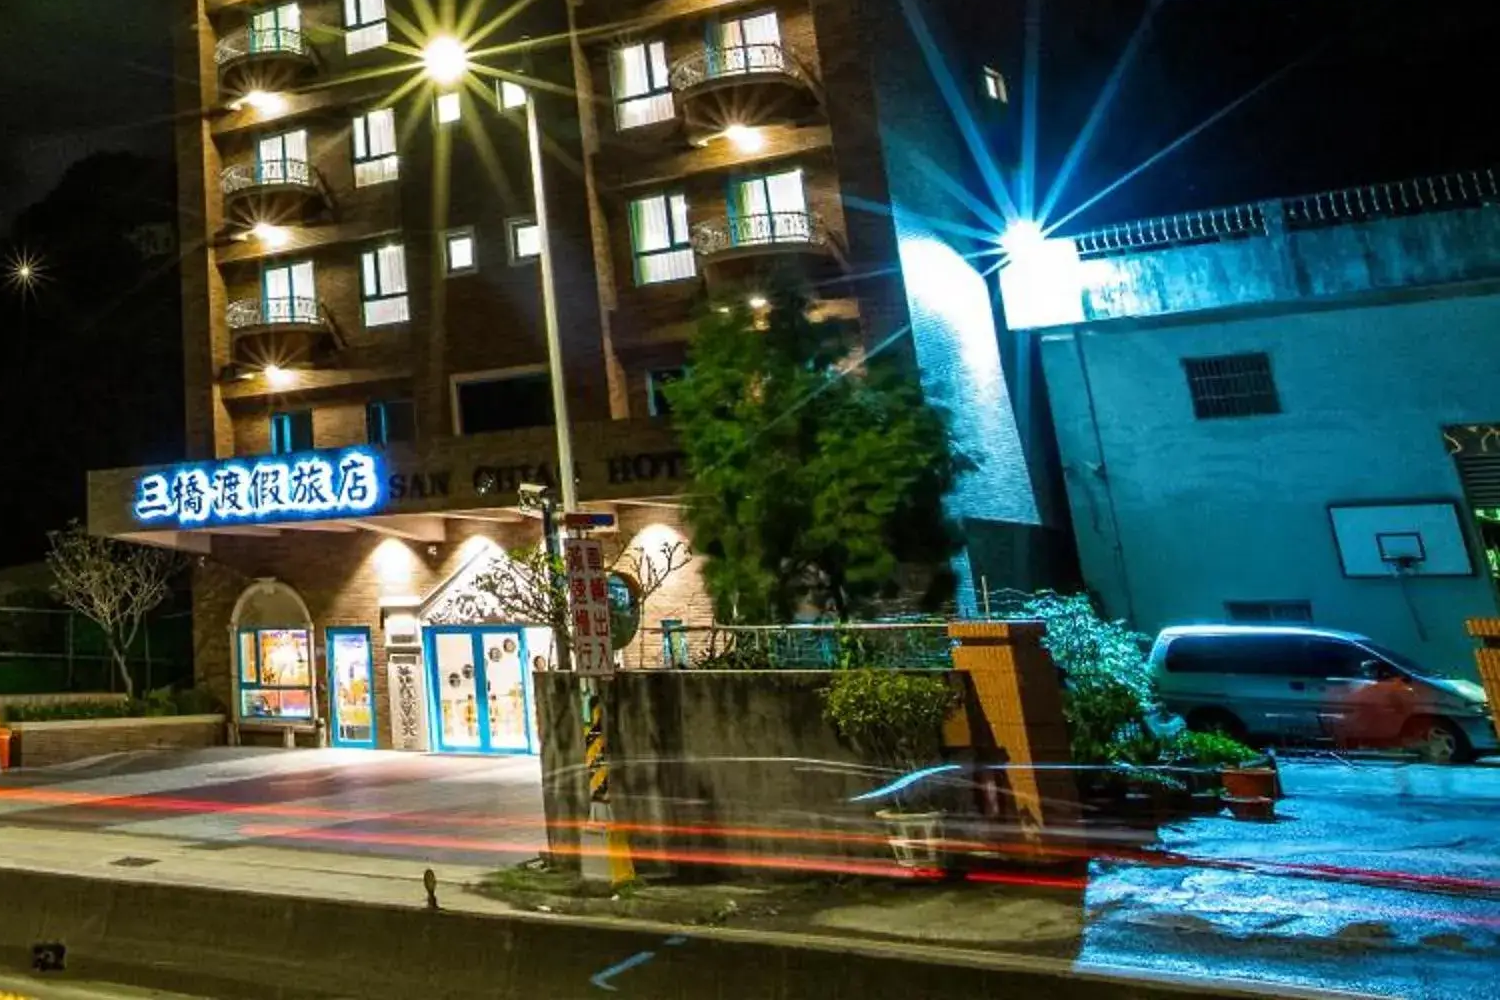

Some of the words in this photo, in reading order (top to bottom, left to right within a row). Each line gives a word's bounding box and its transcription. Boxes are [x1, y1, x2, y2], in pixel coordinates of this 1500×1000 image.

[137, 458, 369, 515] 三橋渡假旅店
[388, 470, 451, 499] SAN
[472, 459, 582, 493] CHIA
